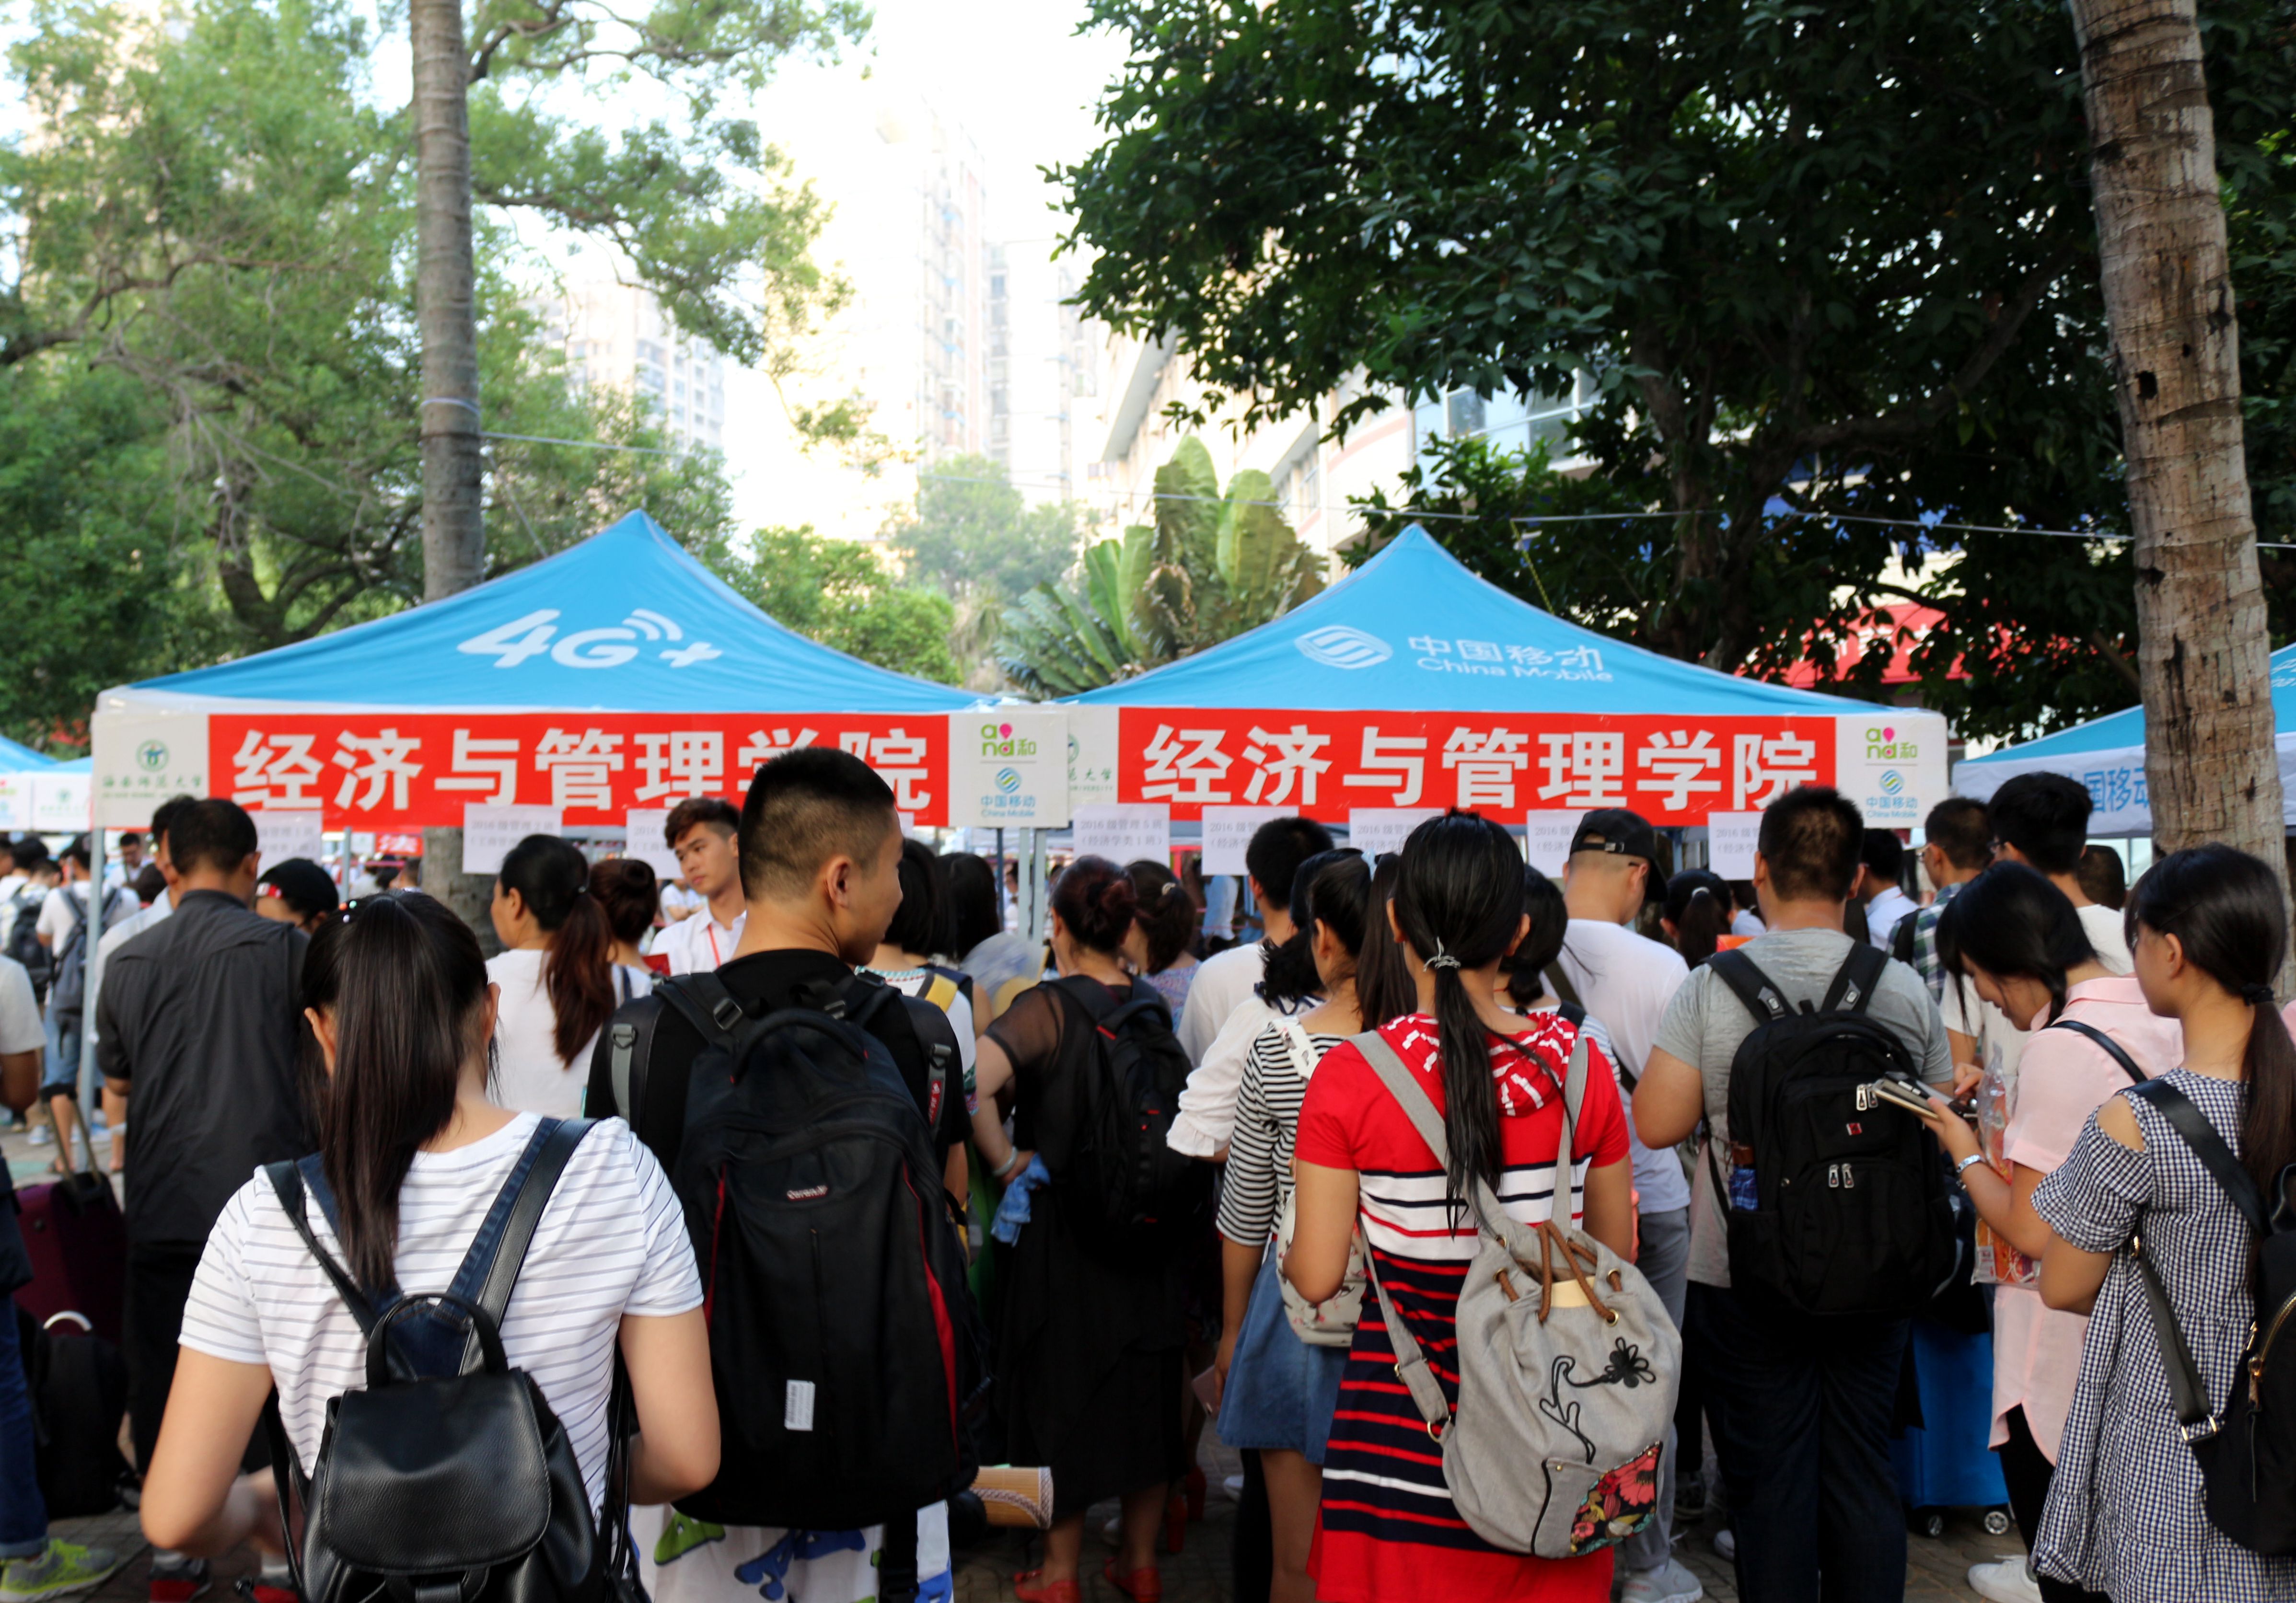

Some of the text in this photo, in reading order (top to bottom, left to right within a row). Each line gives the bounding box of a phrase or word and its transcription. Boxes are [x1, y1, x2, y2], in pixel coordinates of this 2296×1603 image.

[1408, 635, 1604, 671] 中国移动
[1417, 657, 1614, 682] China Mobile
[1141, 724, 1817, 811] 经济与管理学院
[981, 795, 1035, 807] 中国移动
[1866, 796, 1918, 809] 中国移动
